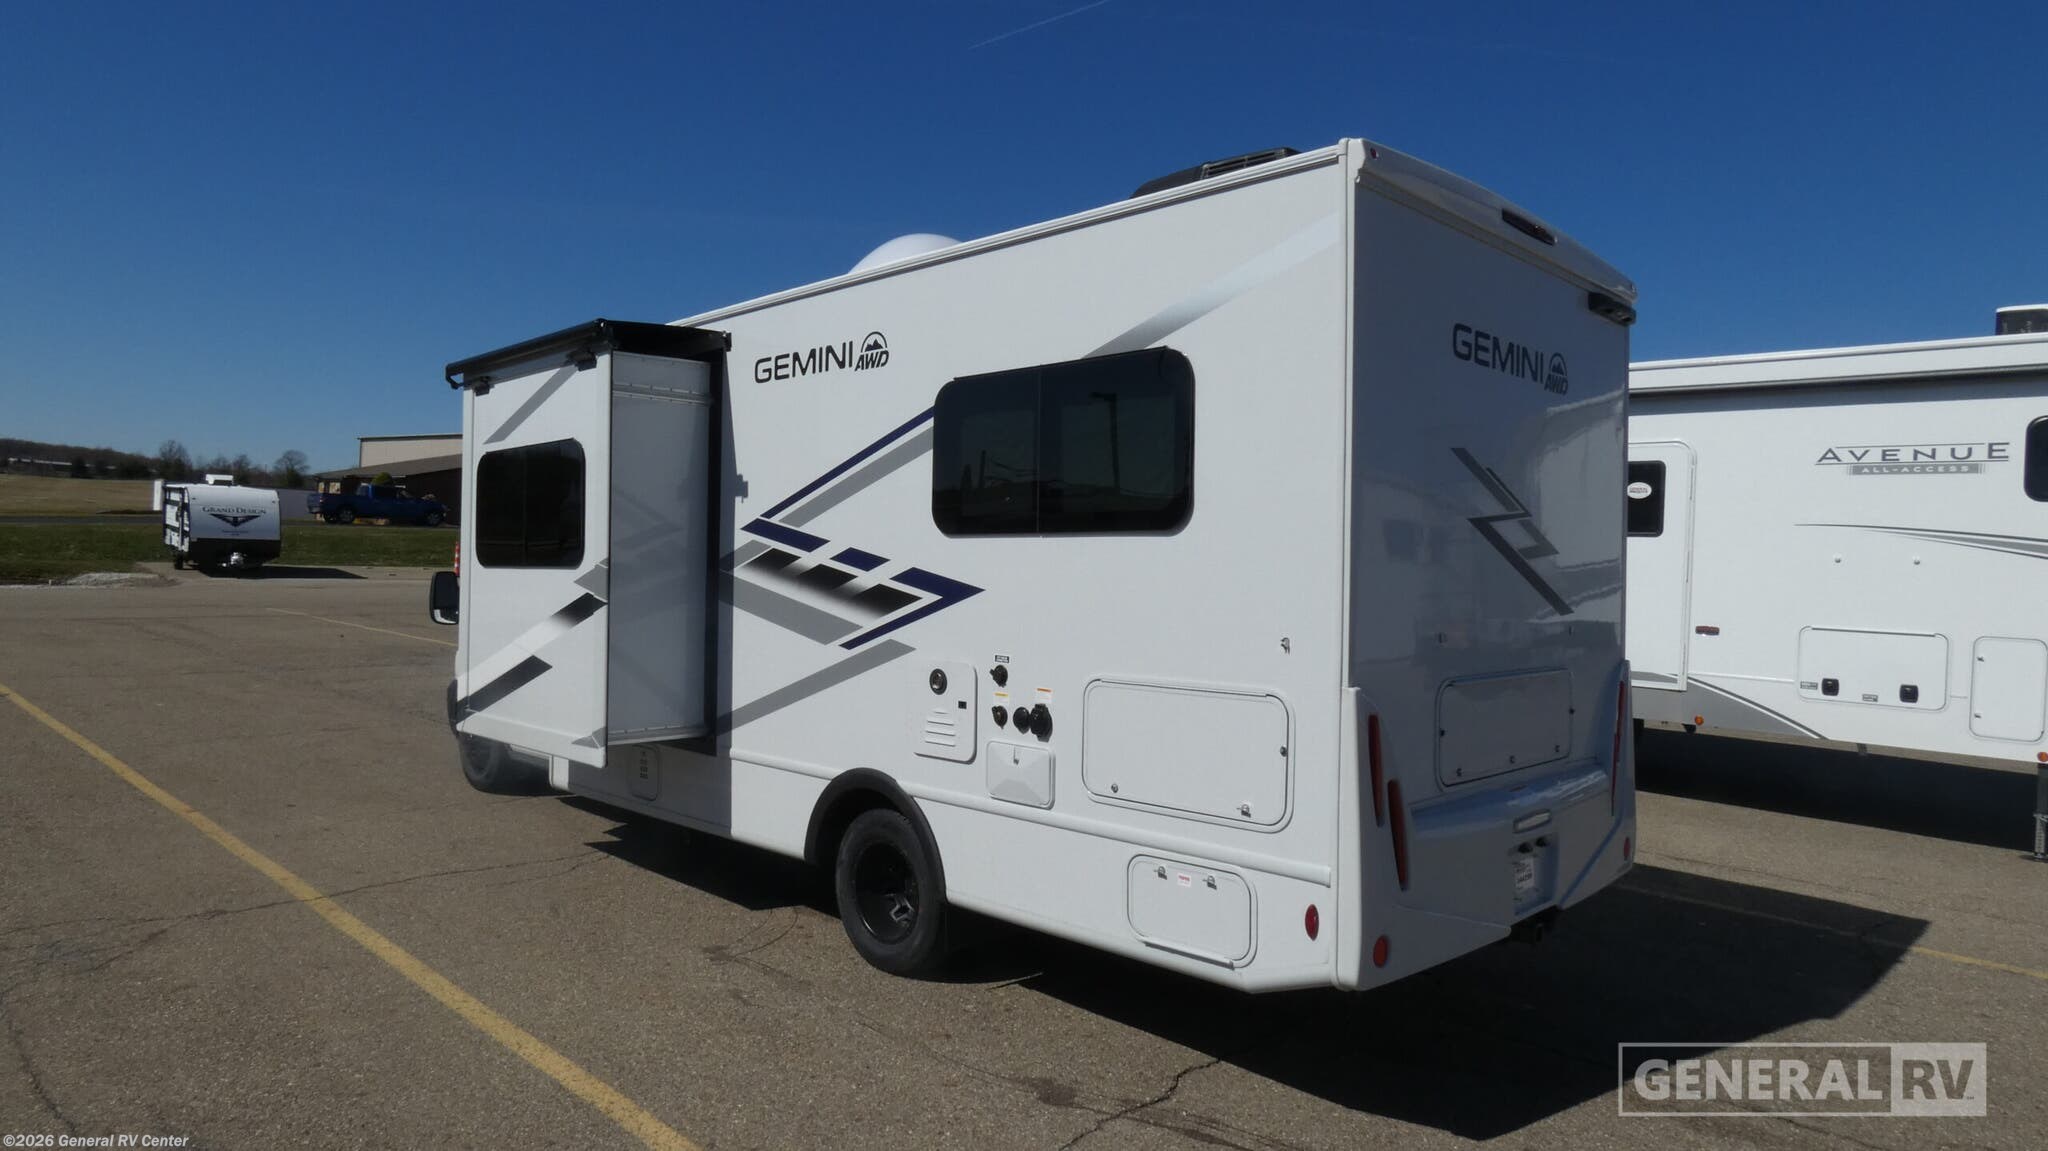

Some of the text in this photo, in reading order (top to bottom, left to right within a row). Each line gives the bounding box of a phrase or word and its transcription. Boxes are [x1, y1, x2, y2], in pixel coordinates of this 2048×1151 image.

[754, 340, 890, 383] GEMINI AWD
[1453, 322, 1569, 395] GEMINI AWD
[1817, 442, 2010, 463] AVENUE
[1861, 465, 1970, 474] ALL-ACCESS
[202, 506, 267, 515] GRAND DESIGN
